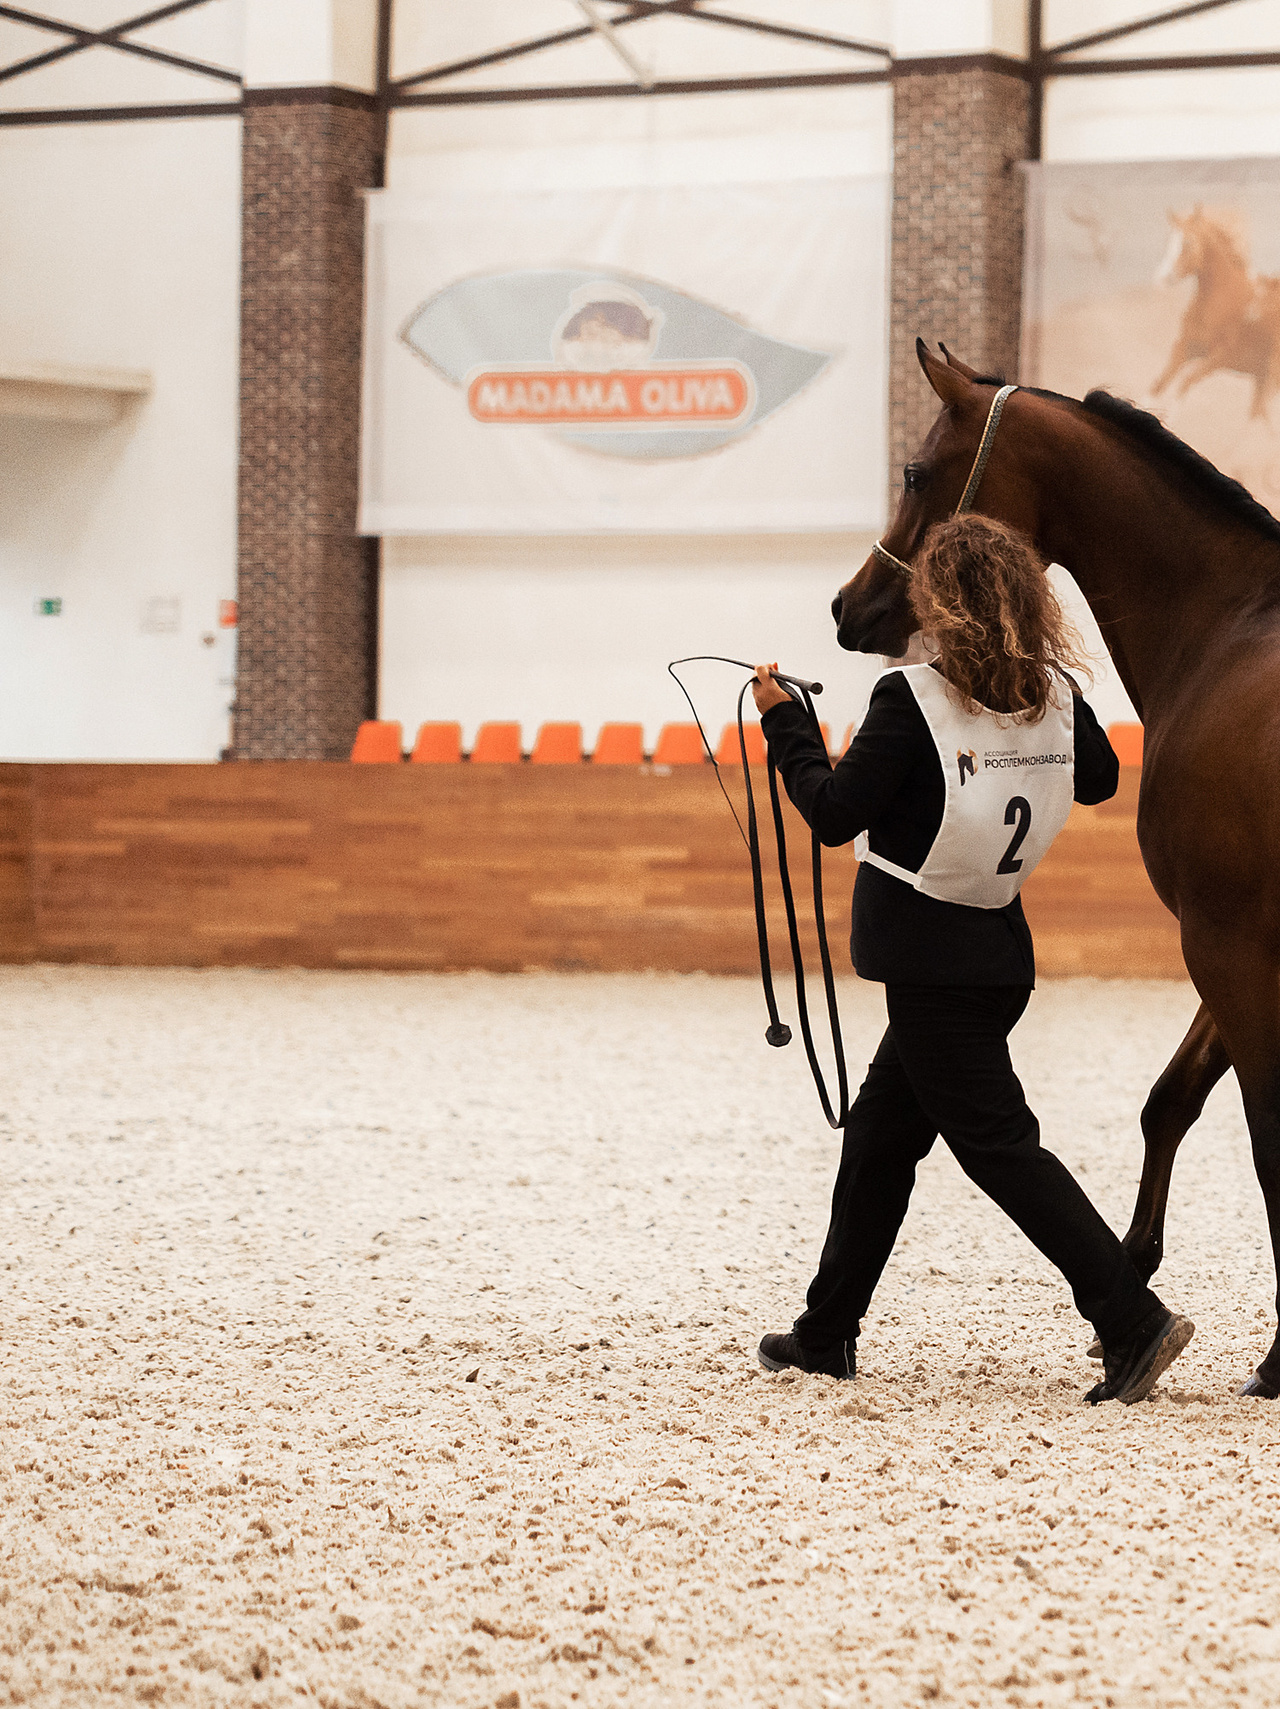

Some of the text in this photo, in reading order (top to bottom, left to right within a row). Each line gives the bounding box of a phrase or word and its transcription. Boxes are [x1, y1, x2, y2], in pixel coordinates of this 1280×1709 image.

[476, 376, 736, 414] MADAMA OLIVA
[984, 754, 1067, 769] РОСПЛЕМКОНЗАВОД
[996, 796, 1032, 875] 2
